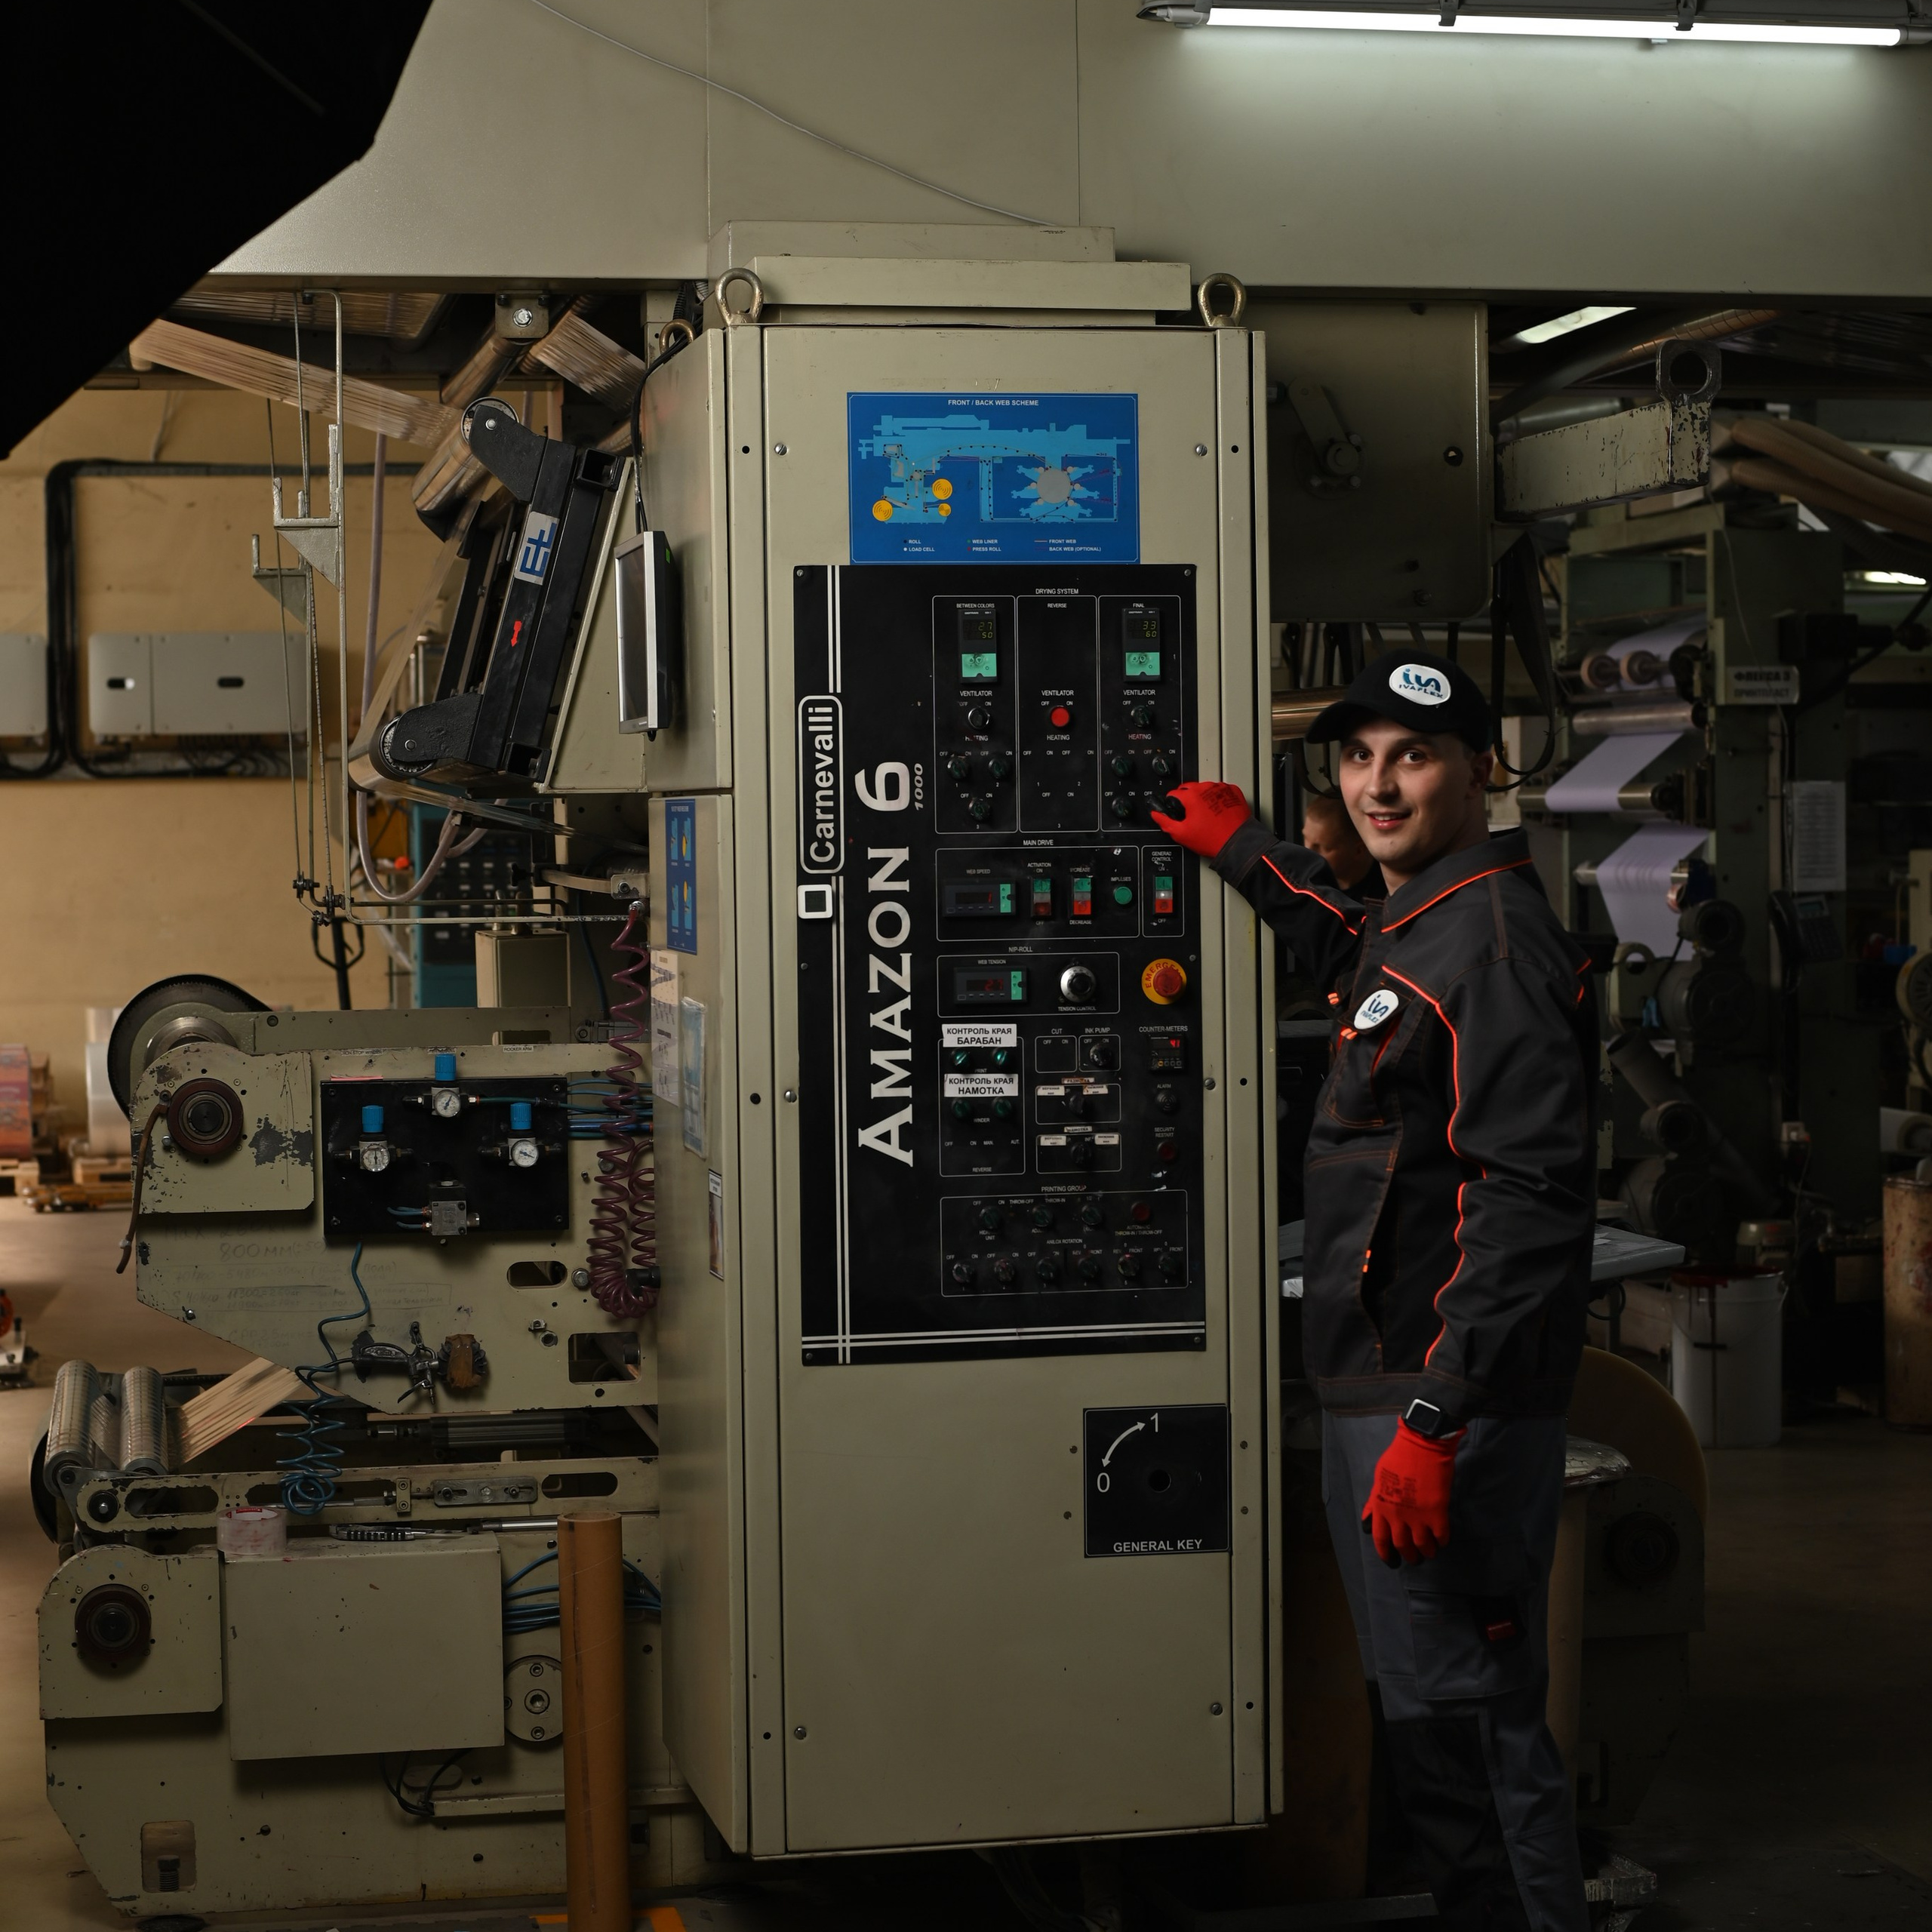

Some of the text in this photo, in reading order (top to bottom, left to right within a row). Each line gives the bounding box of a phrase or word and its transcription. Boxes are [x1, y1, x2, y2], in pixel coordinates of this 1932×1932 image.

[978, 621, 993, 631] 27
[1142, 620, 1157, 630] 33
[1398, 684, 1444, 700] IVAFLEX
[808, 706, 835, 863] Carnevalli
[914, 763, 924, 811] 1000
[854, 761, 913, 1168] AMAZON 6
[957, 1037, 1001, 1045] БАРАБАН
[1150, 1412, 1159, 1432] 1
[1097, 1472, 1110, 1493] 0
[1113, 1539, 1202, 1552] GENERAL KEY
